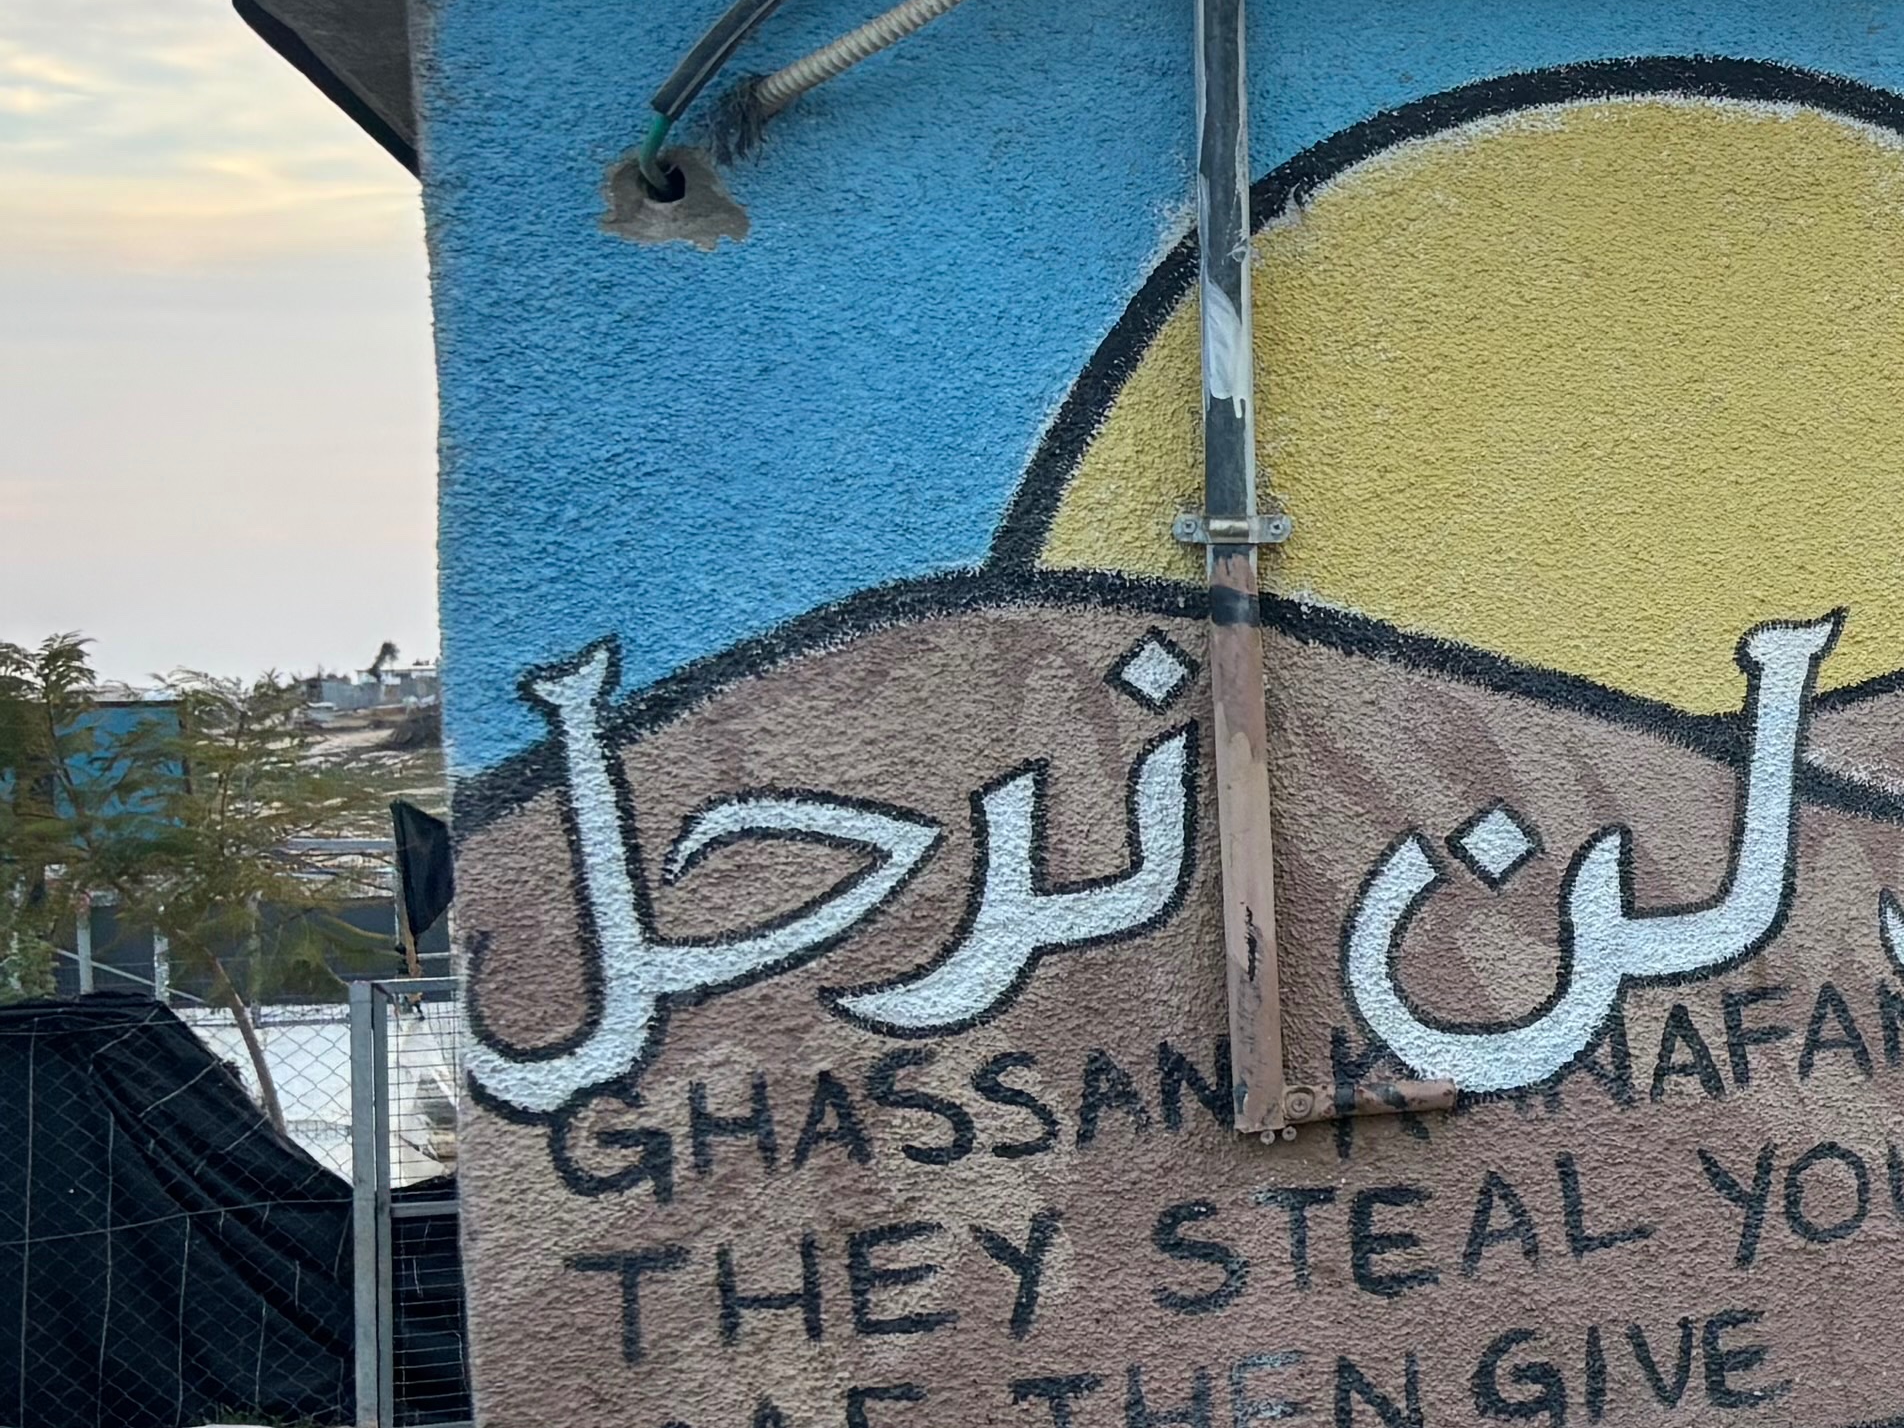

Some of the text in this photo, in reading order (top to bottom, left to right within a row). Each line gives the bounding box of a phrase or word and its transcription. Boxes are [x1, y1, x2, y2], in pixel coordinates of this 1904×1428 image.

[463, 627, 1205, 1120] نرحل
[1340, 607, 1845, 1097] لن
[548, 1032, 1240, 1204] GHASSAN
[563, 1207, 1063, 1364] THEY
[1150, 1152, 1655, 1317] STEAL
